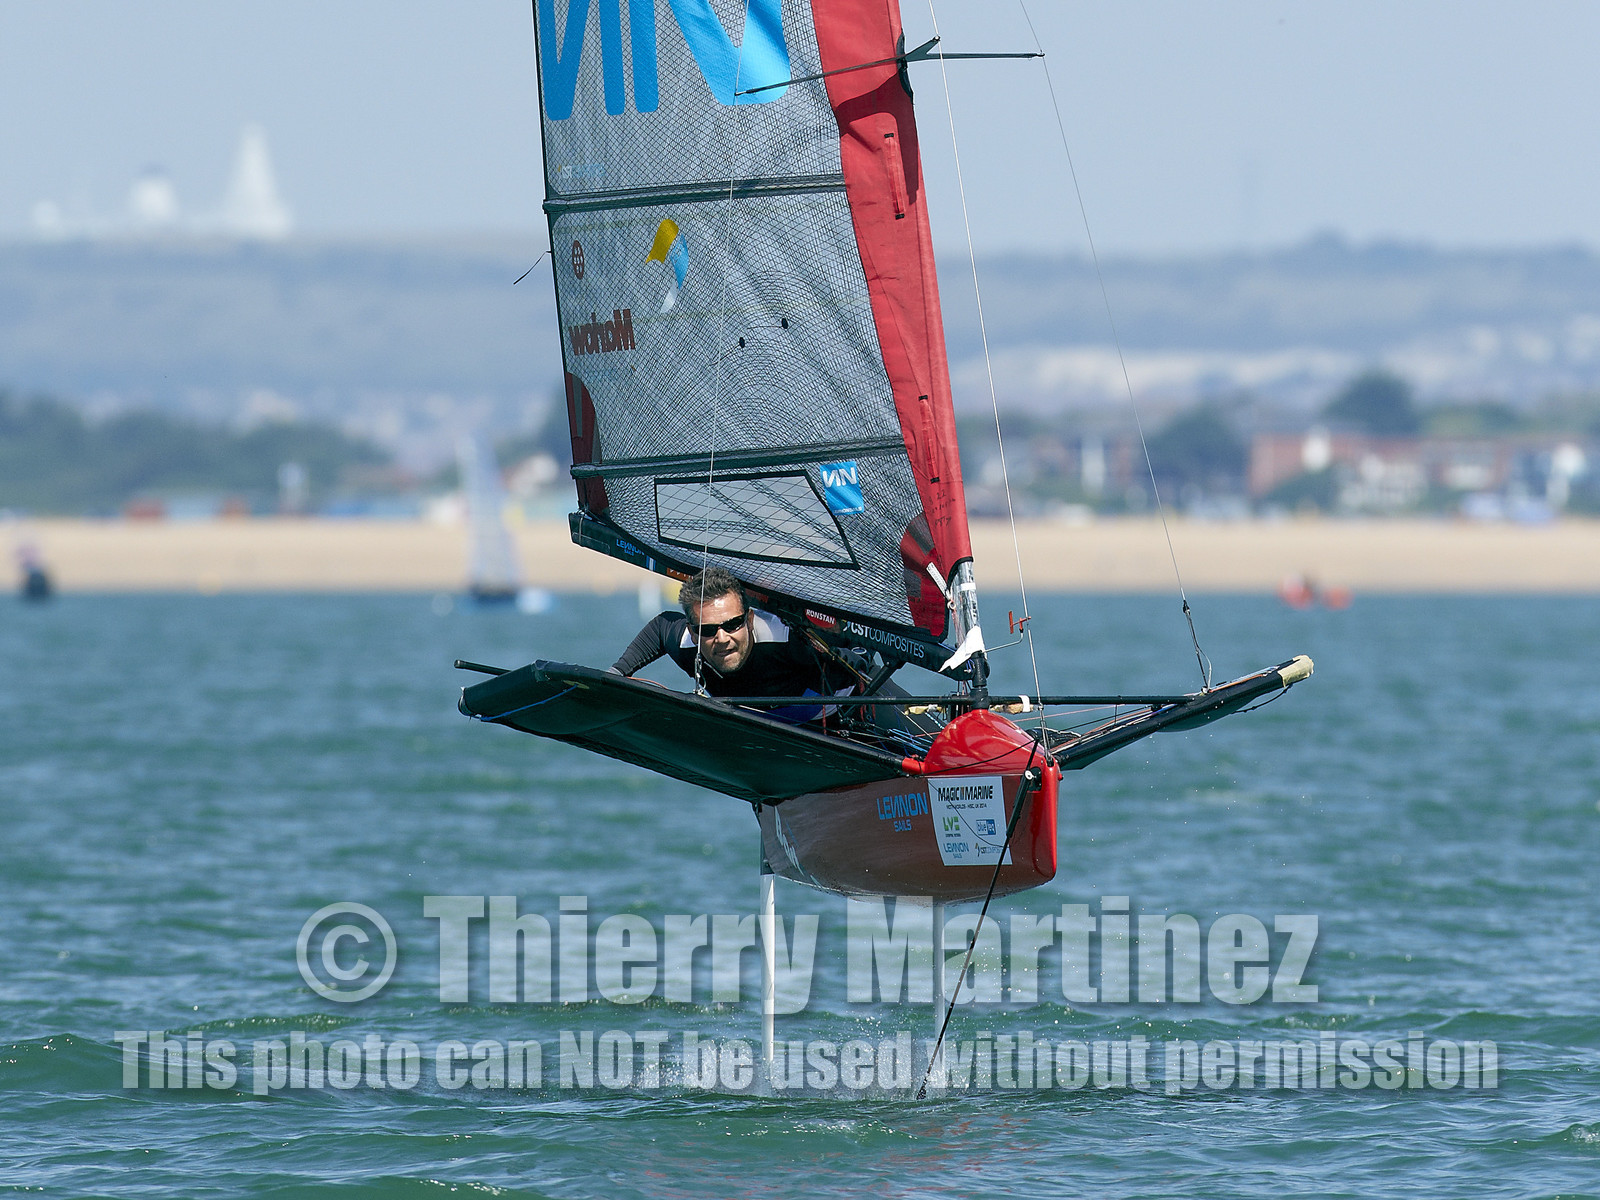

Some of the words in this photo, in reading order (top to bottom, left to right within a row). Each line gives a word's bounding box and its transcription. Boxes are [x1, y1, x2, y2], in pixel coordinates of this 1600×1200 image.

[806, 608, 836, 625] RONSTAN
[938, 787, 960, 802] MAGIC
[965, 785, 994, 800] MARINE
[893, 819, 912, 833] SAILS
